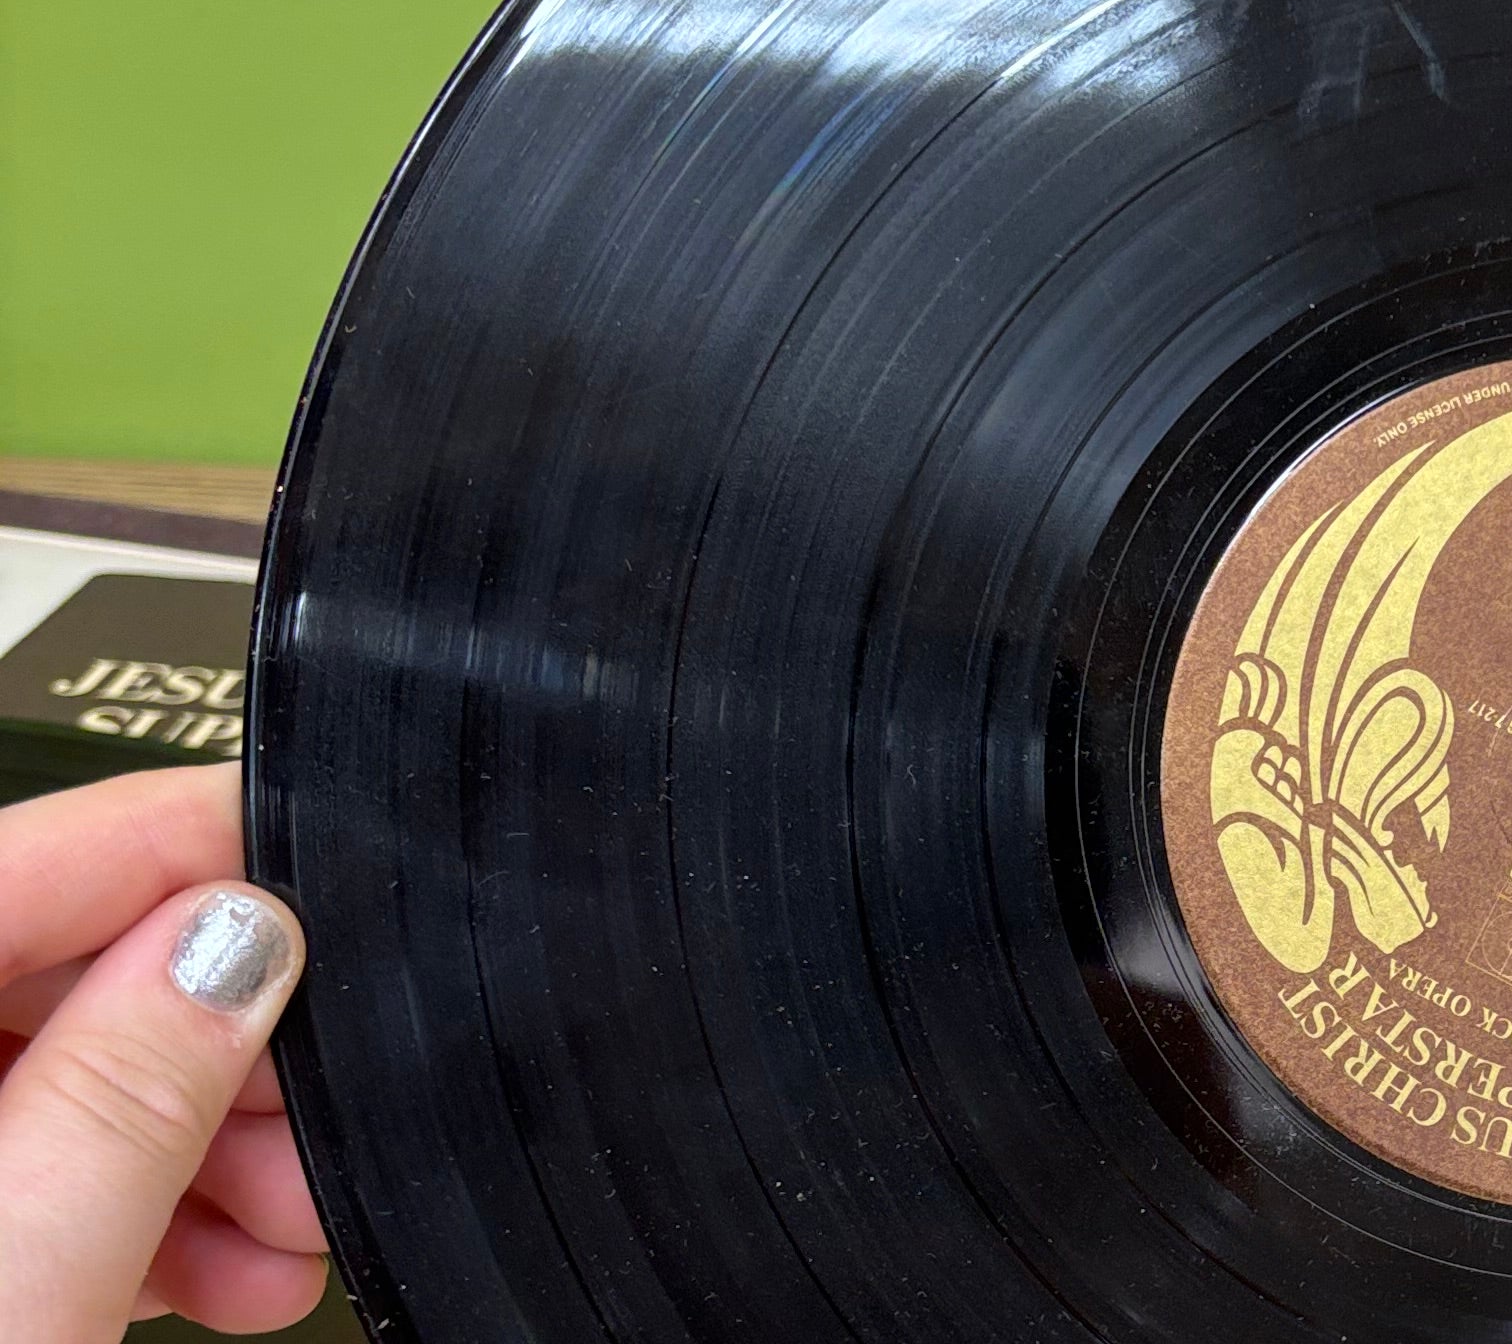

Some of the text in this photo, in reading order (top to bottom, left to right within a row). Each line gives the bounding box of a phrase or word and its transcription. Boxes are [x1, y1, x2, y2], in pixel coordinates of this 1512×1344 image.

[1462, 381, 1510, 404] UNDER
[49, 657, 246, 710] JESU
[1389, 958, 1471, 1016] OPERA
[1277, 978, 1446, 1126] CHRIST
